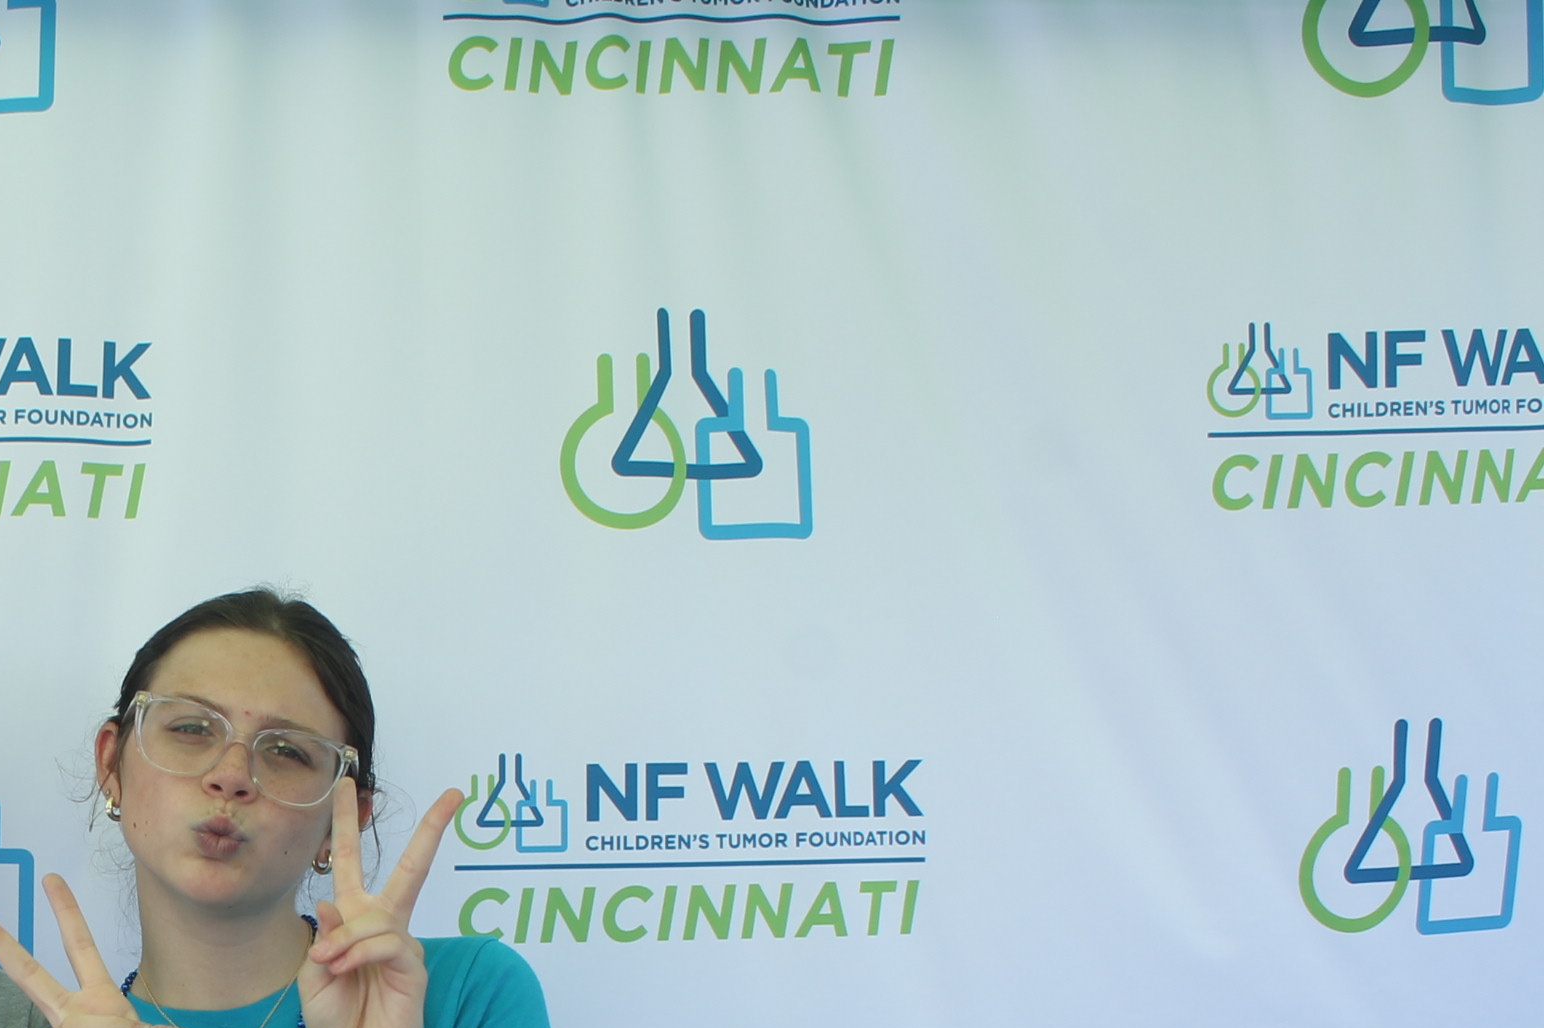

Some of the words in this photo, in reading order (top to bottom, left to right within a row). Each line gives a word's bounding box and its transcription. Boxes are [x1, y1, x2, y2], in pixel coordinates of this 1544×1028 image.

[448, 34, 895, 97] CINCINNATI
[1327, 329, 1426, 390] NF
[14, 409, 153, 428] FOUNDATION
[1328, 400, 1445, 418] CHILDREN'S
[1451, 398, 1511, 415] TUMOR
[586, 762, 688, 822] NF
[703, 759, 924, 821] WALK
[585, 833, 710, 852] CHILDREN'S
[716, 832, 788, 850] TUMOR
[795, 829, 926, 848] FOUNDATION
[458, 879, 920, 944] CINCINNATI
